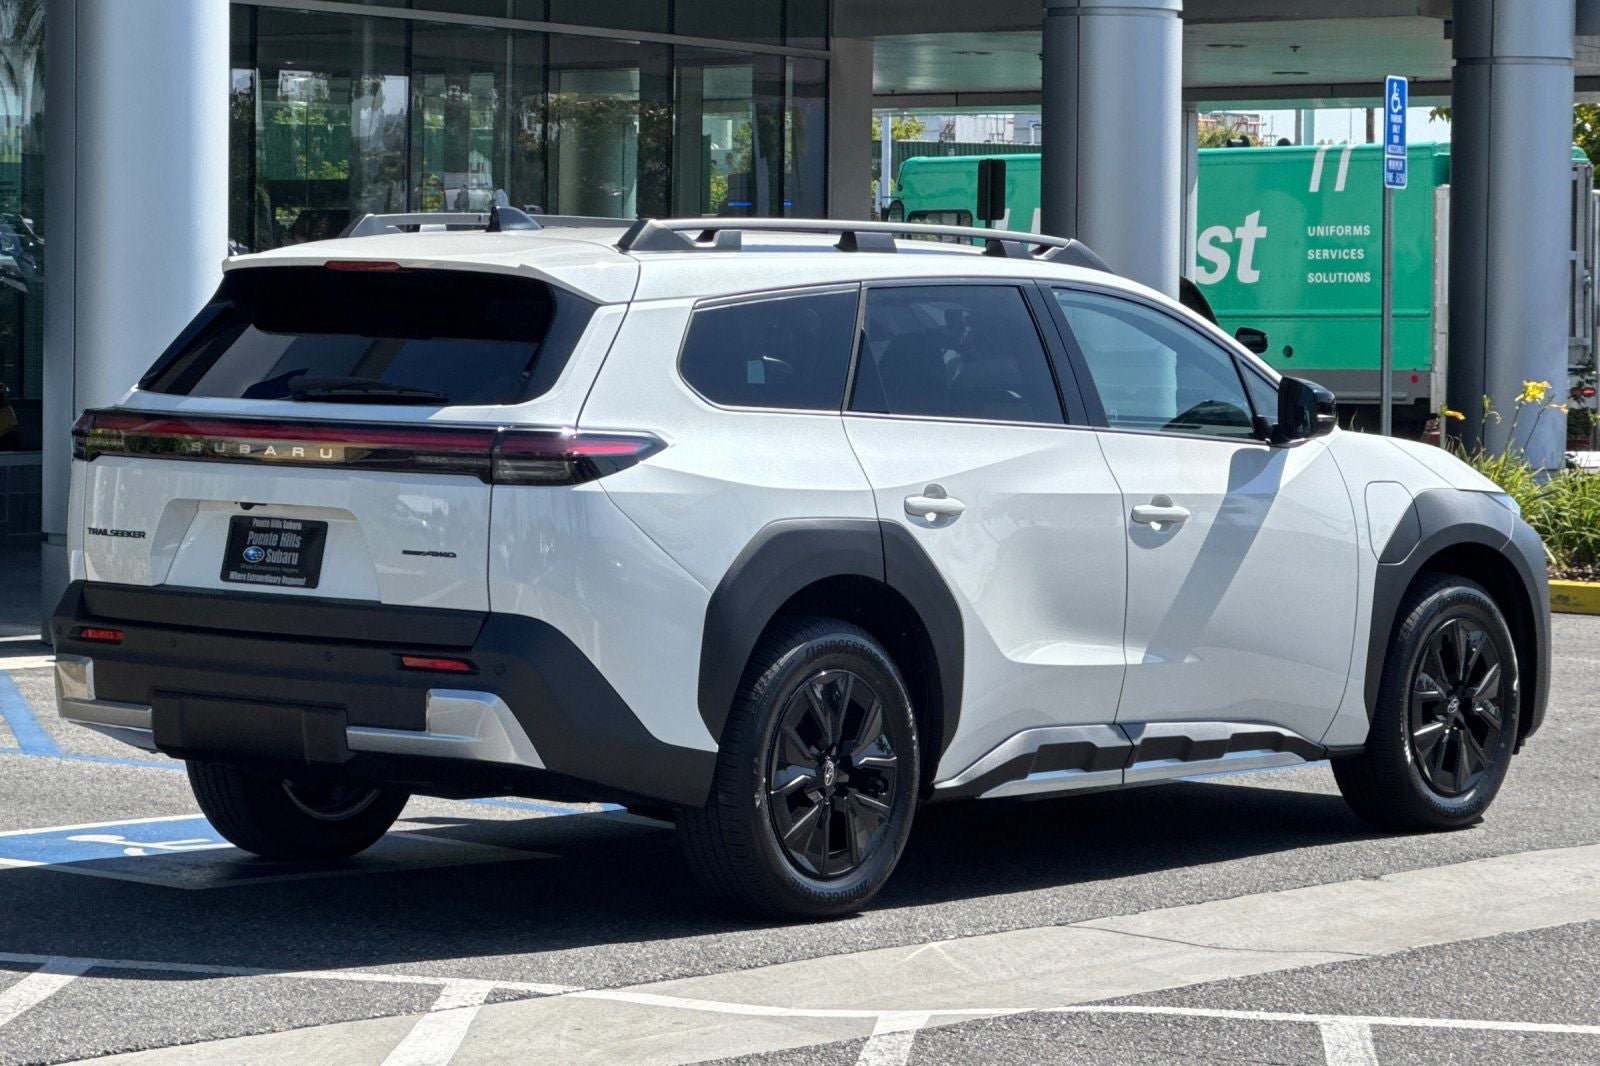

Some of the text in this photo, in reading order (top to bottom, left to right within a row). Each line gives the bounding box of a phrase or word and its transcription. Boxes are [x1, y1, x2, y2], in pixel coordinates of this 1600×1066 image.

[1307, 224, 1371, 237] UNIFORMS
[1195, 209, 1268, 285] st
[1307, 248, 1365, 260] SERVICES
[1307, 271, 1372, 284] SOLUTIONS
[190, 441, 333, 459] SUBARU
[282, 519, 302, 531] Subaru
[246, 530, 302, 549] Puente Hills
[265, 548, 299, 566] Subaru
